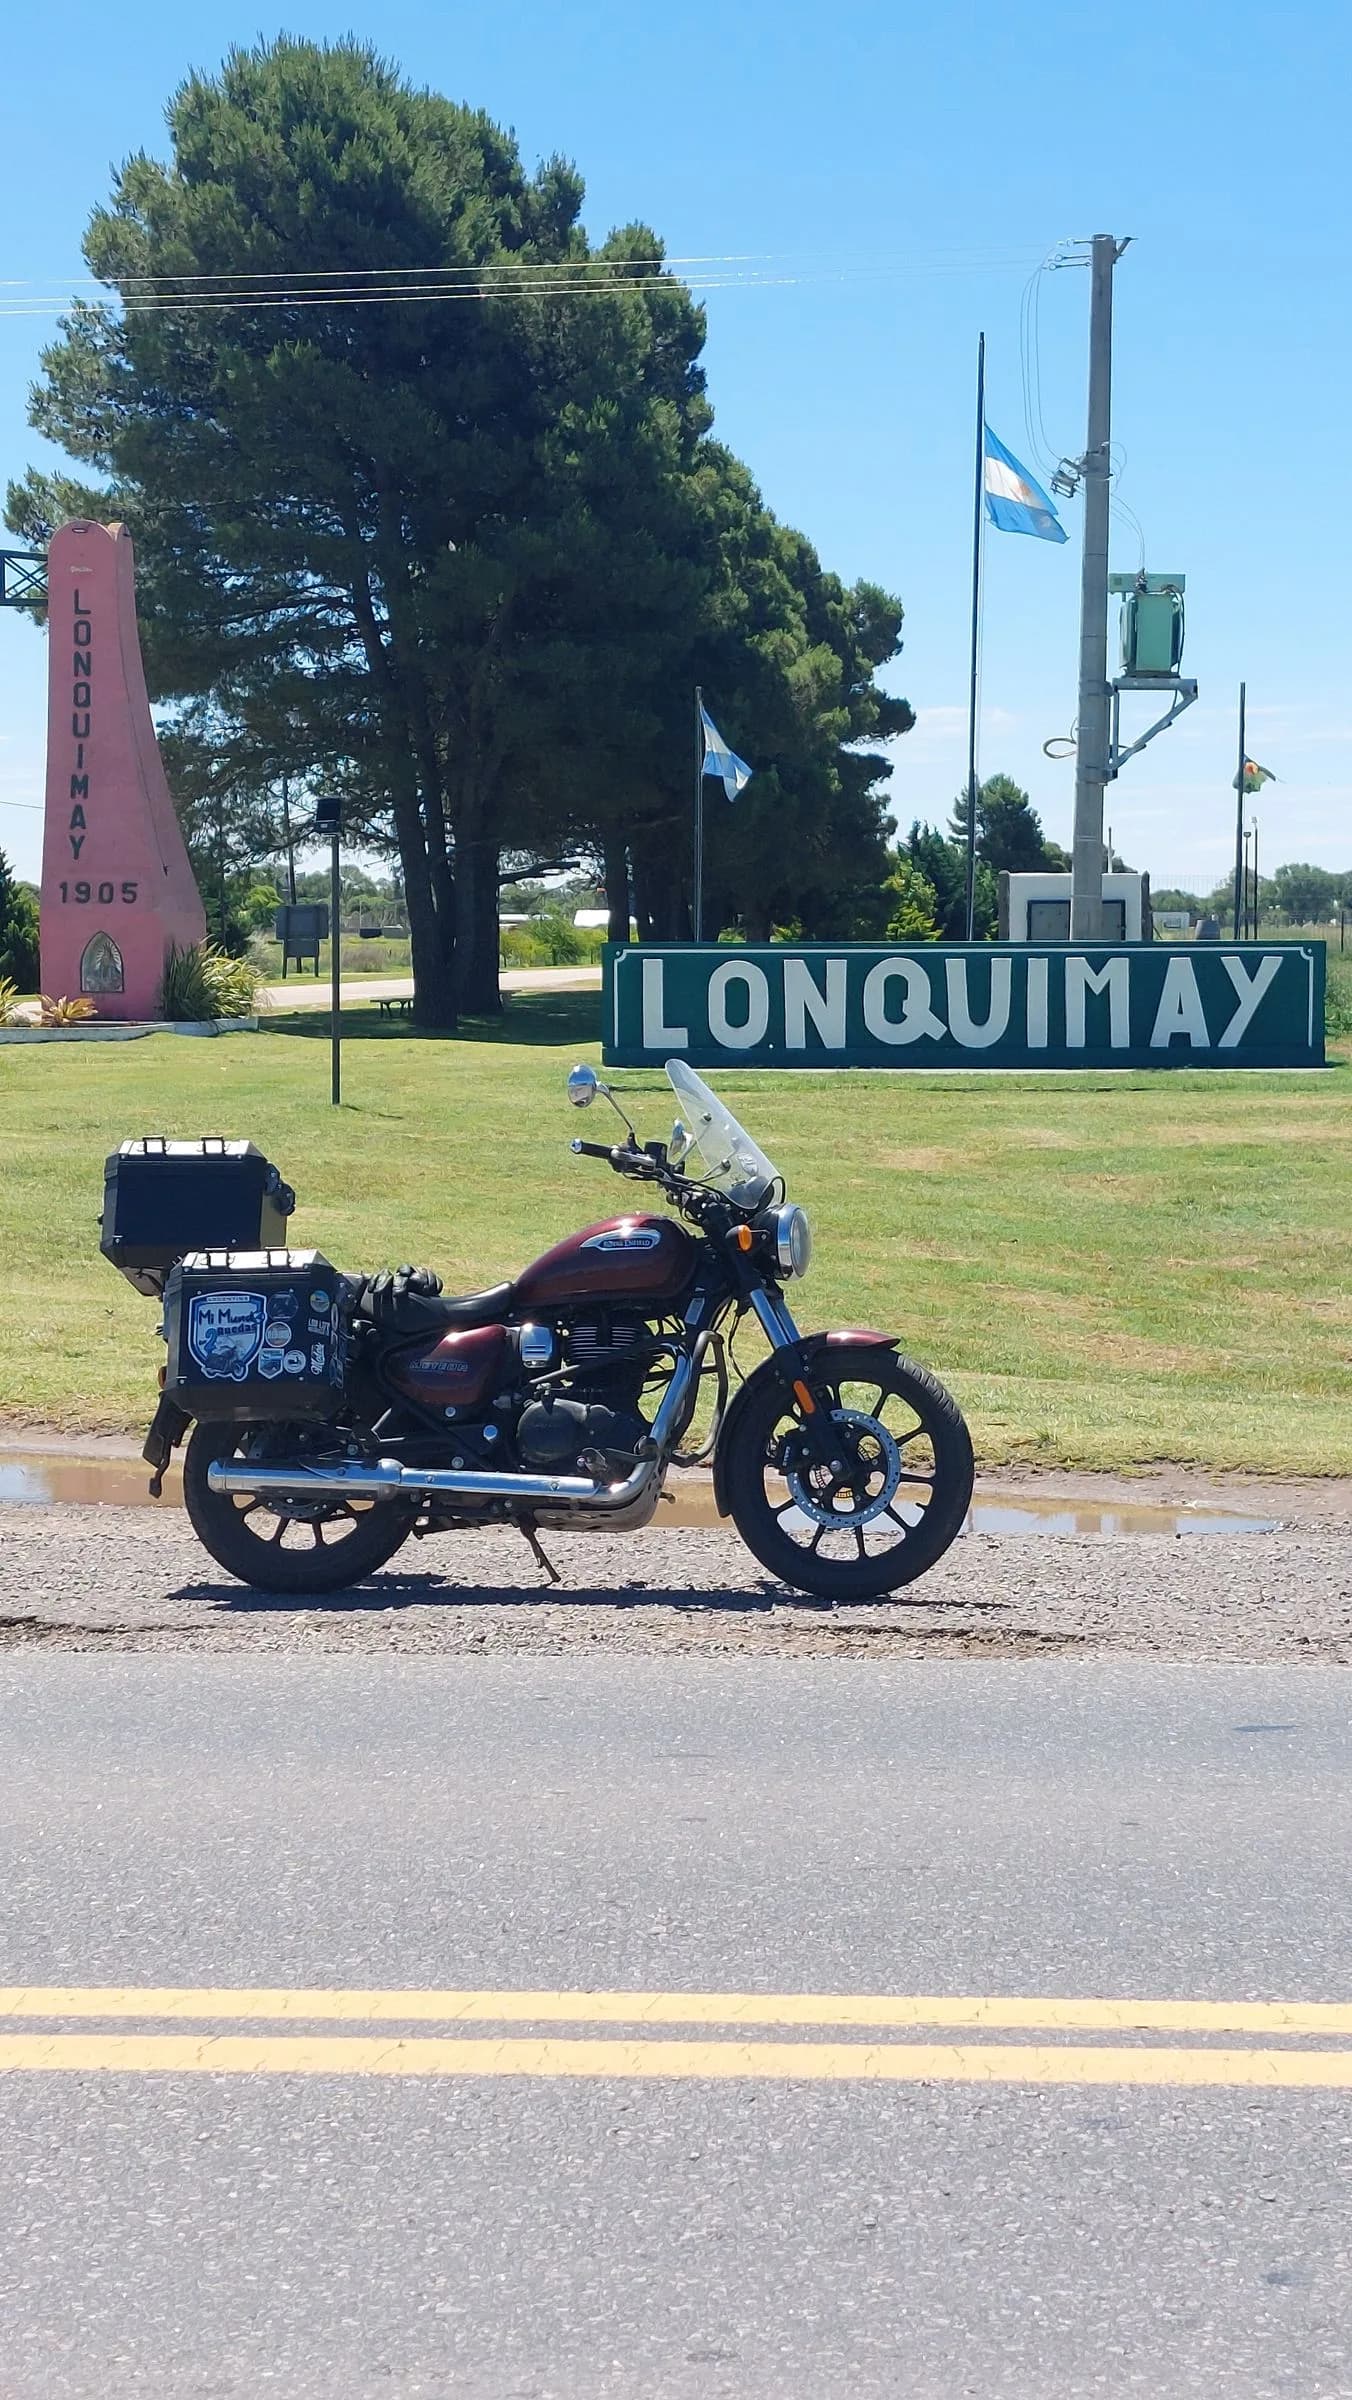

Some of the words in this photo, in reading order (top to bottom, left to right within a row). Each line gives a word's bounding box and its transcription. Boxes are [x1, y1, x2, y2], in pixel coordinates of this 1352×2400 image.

[69, 588, 92, 861] LONQUIMAY
[59, 881, 138, 904] 1905
[642, 954, 1284, 1049] LONQUIMAY
[199, 1309, 214, 1325] Mi
